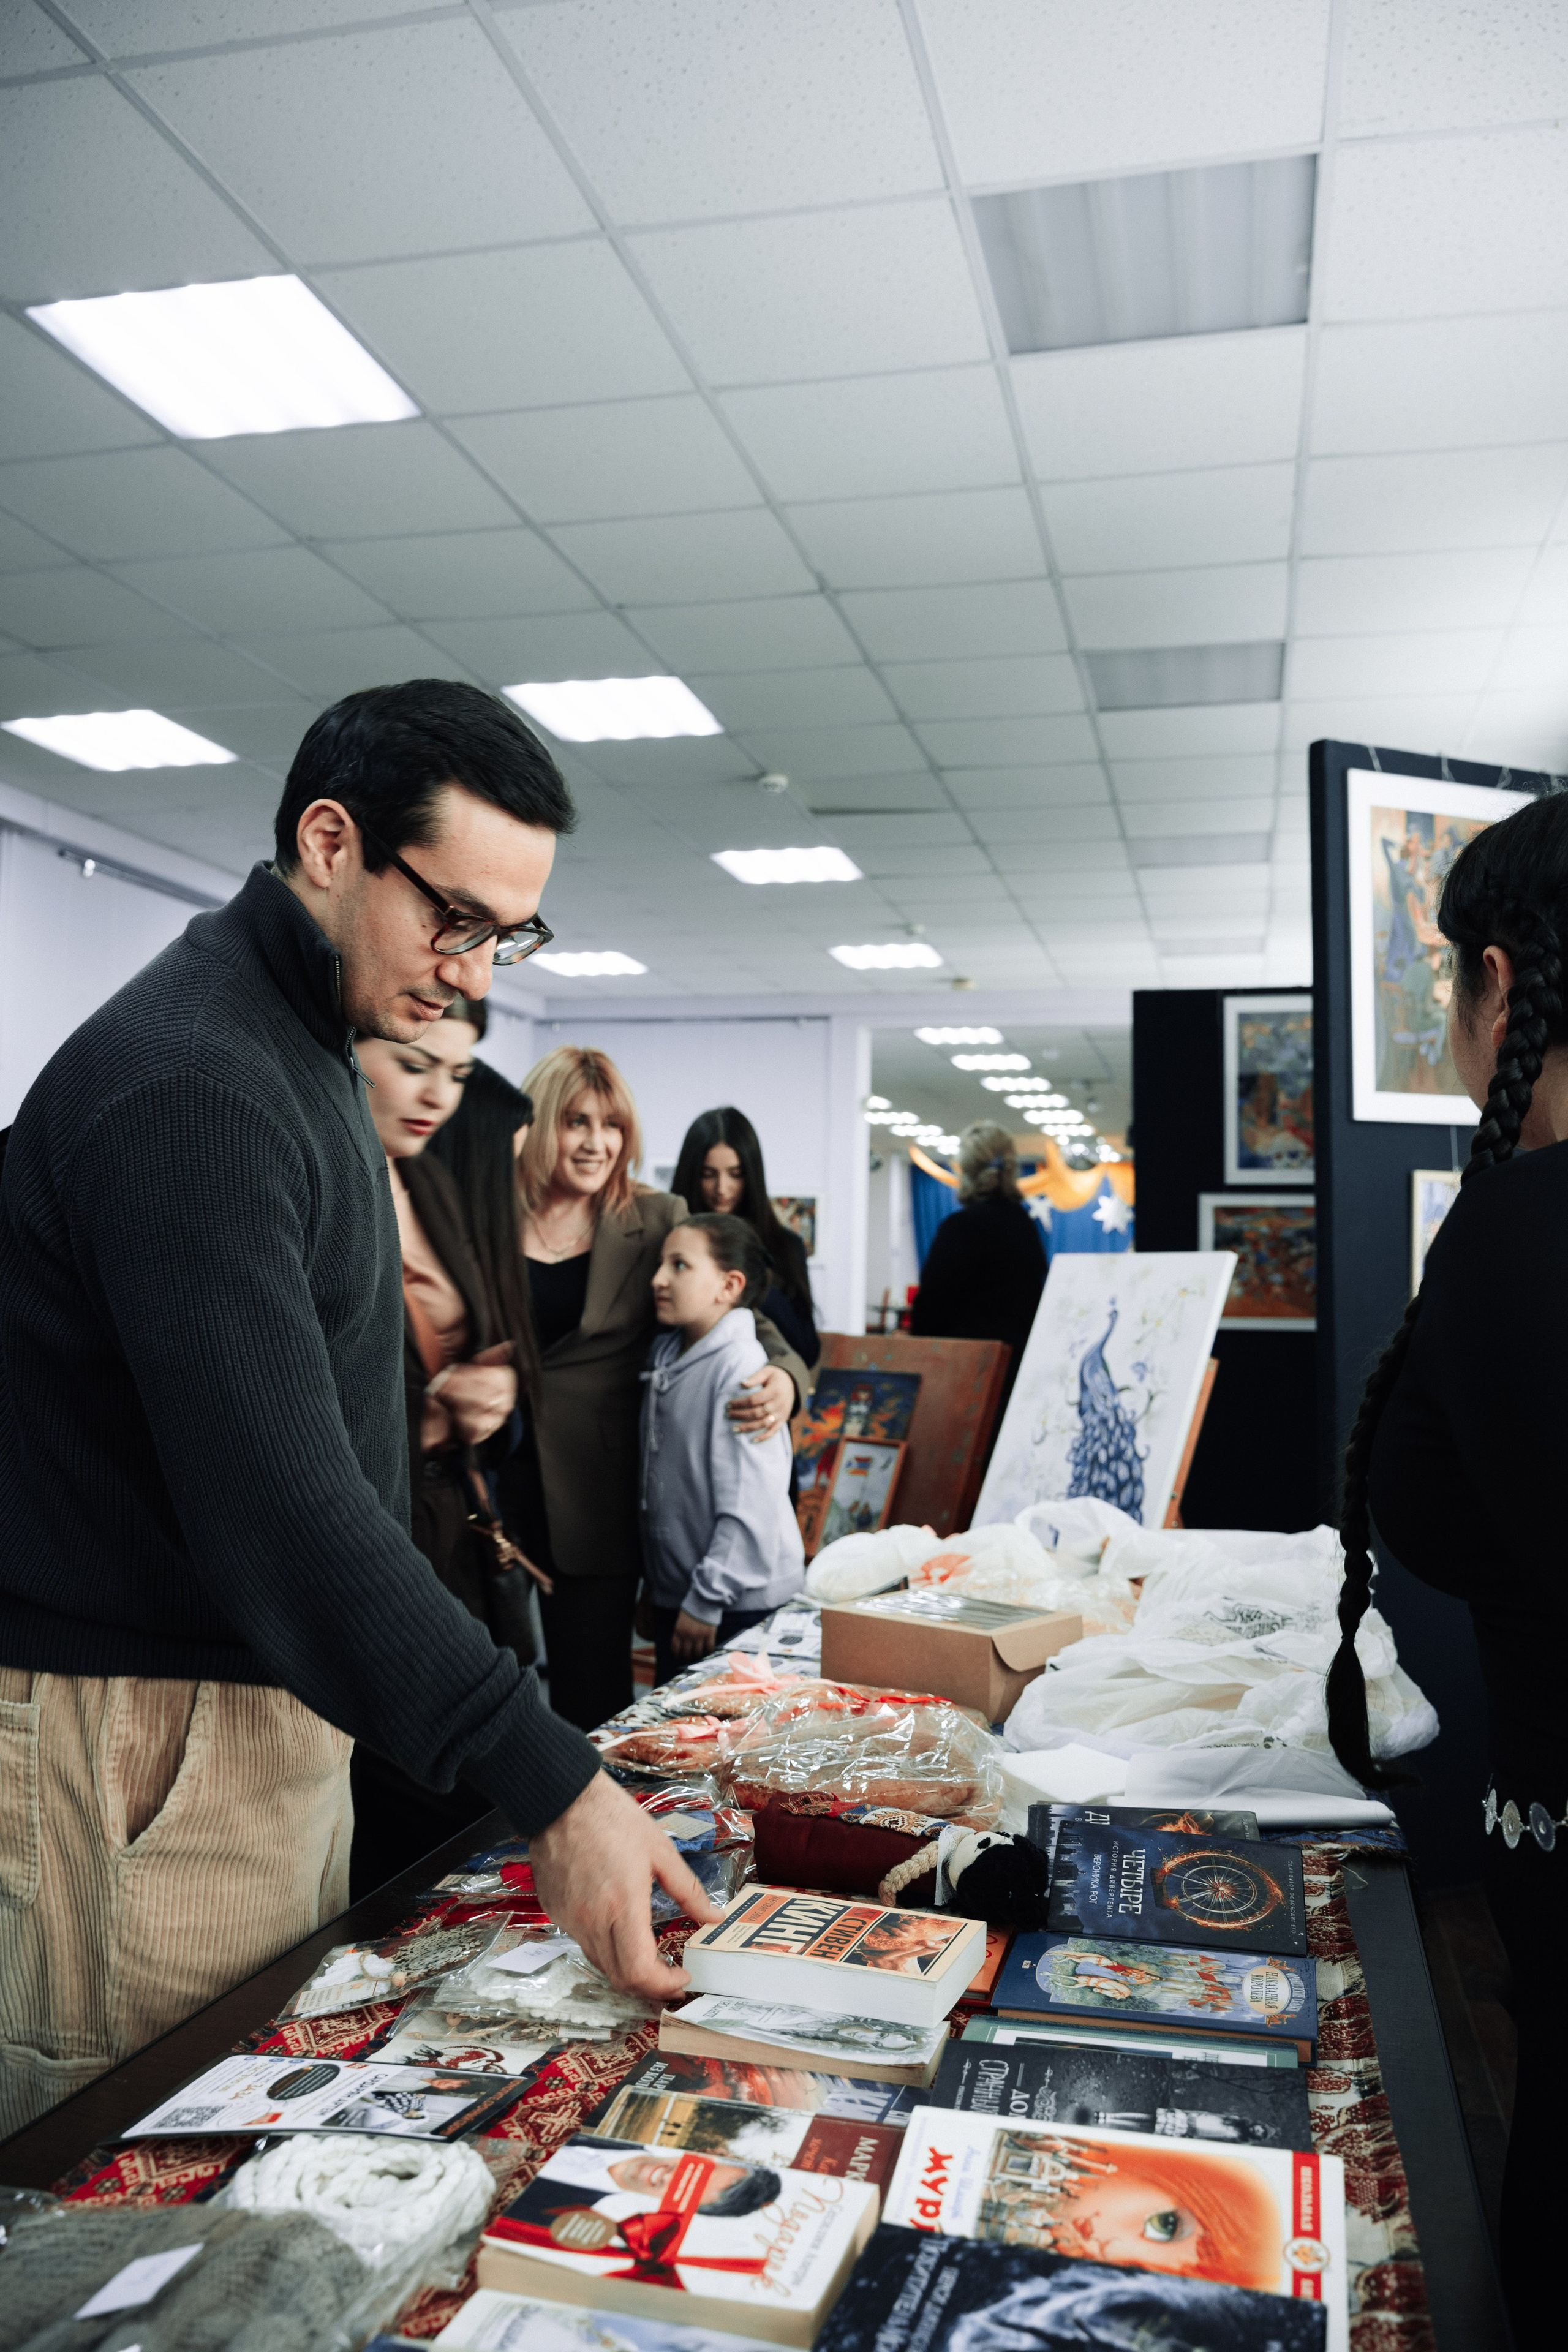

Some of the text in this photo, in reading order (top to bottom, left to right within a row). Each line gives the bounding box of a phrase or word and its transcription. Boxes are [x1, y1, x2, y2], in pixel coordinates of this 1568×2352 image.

[1088, 1853, 1102, 1905] ВЕРОНИКА РОТ
[1105, 1840, 1119, 1918] ИСТОРИЯ ДИВЕРГЕНТА
[1118, 1848, 1147, 1915] ЧЕТЫРЕ
[745, 1896, 782, 1922] МЕРТВАЯ ЗОНА
[752, 1899, 846, 1954] КИНГ
[809, 1917, 868, 1960] СТИВЕН
[1250, 1974, 1264, 2002] КОРОЛЕВА
[1265, 1972, 1278, 2009] НАКАЗАННАЯ
[648, 2060, 669, 2073] ИЗ
